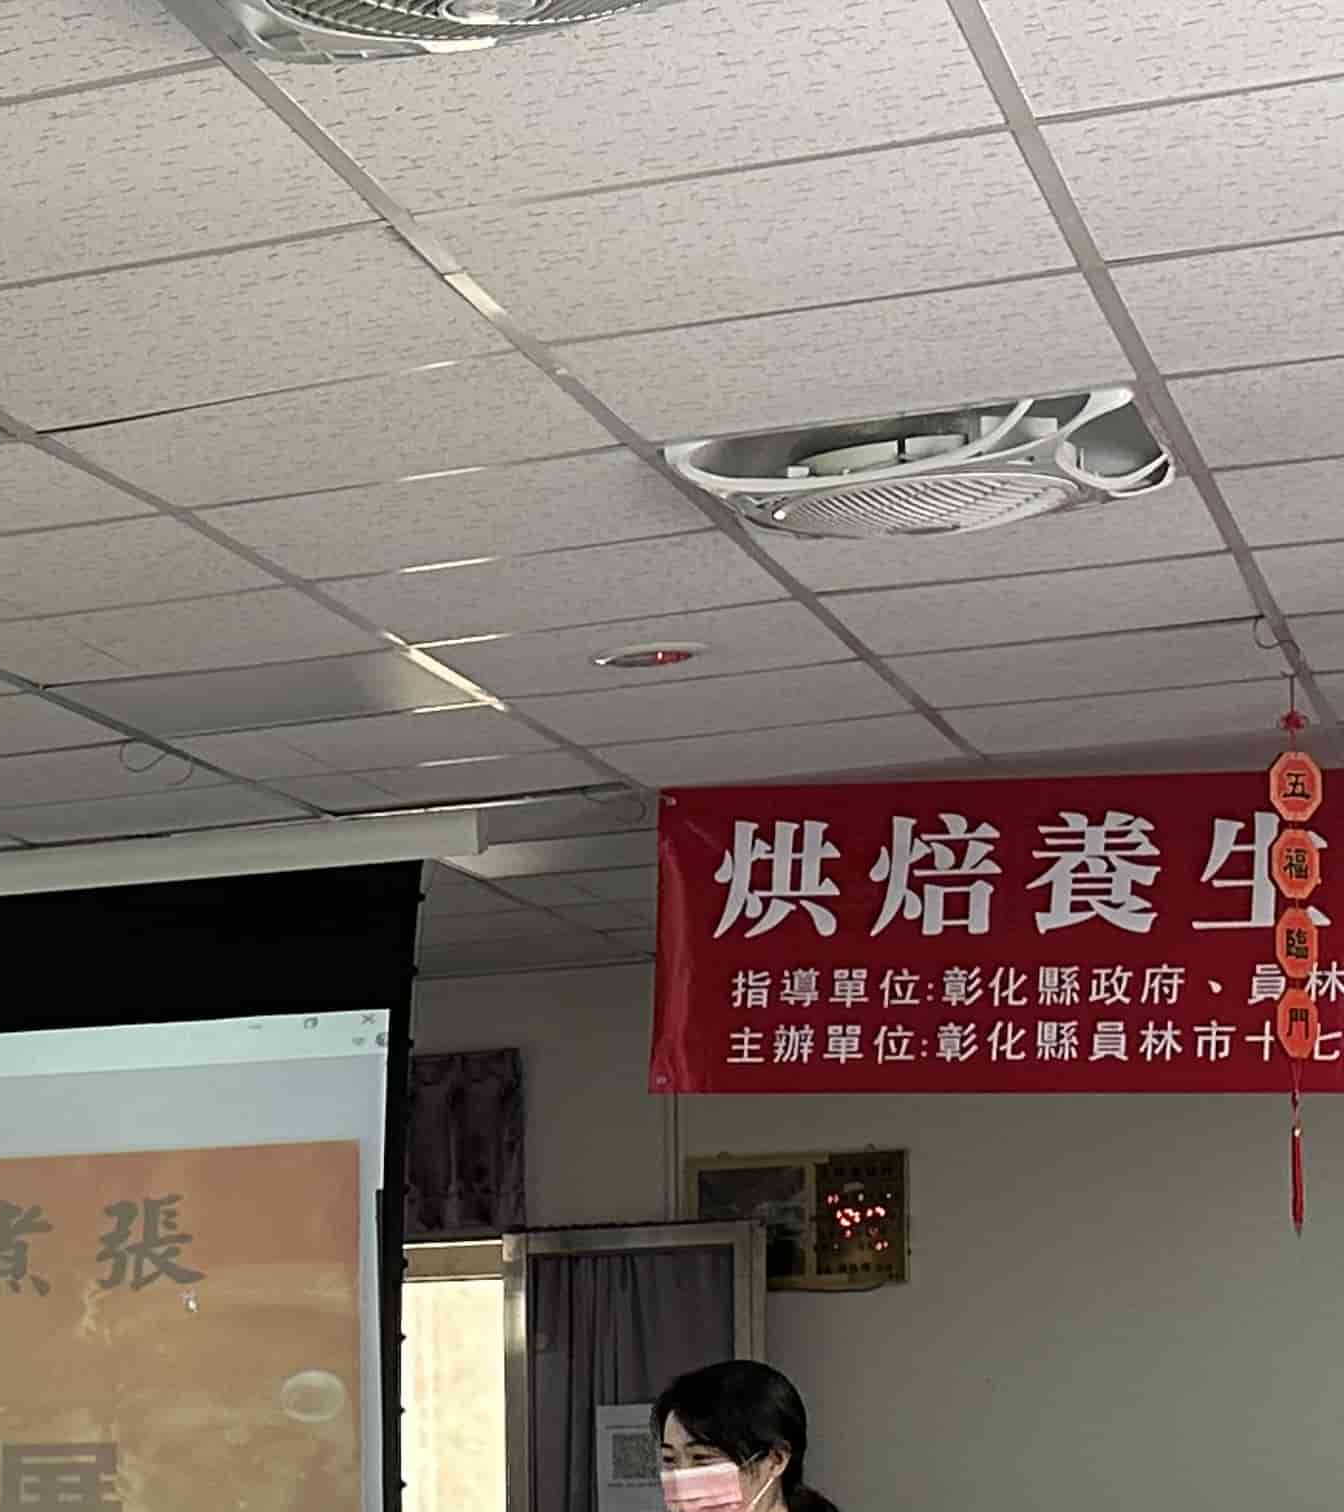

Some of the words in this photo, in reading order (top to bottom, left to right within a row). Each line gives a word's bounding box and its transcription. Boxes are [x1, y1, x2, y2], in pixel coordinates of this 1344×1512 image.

[713, 809, 1331, 939] 烘焙養生
[1282, 772, 1311, 1040] 五福臨門
